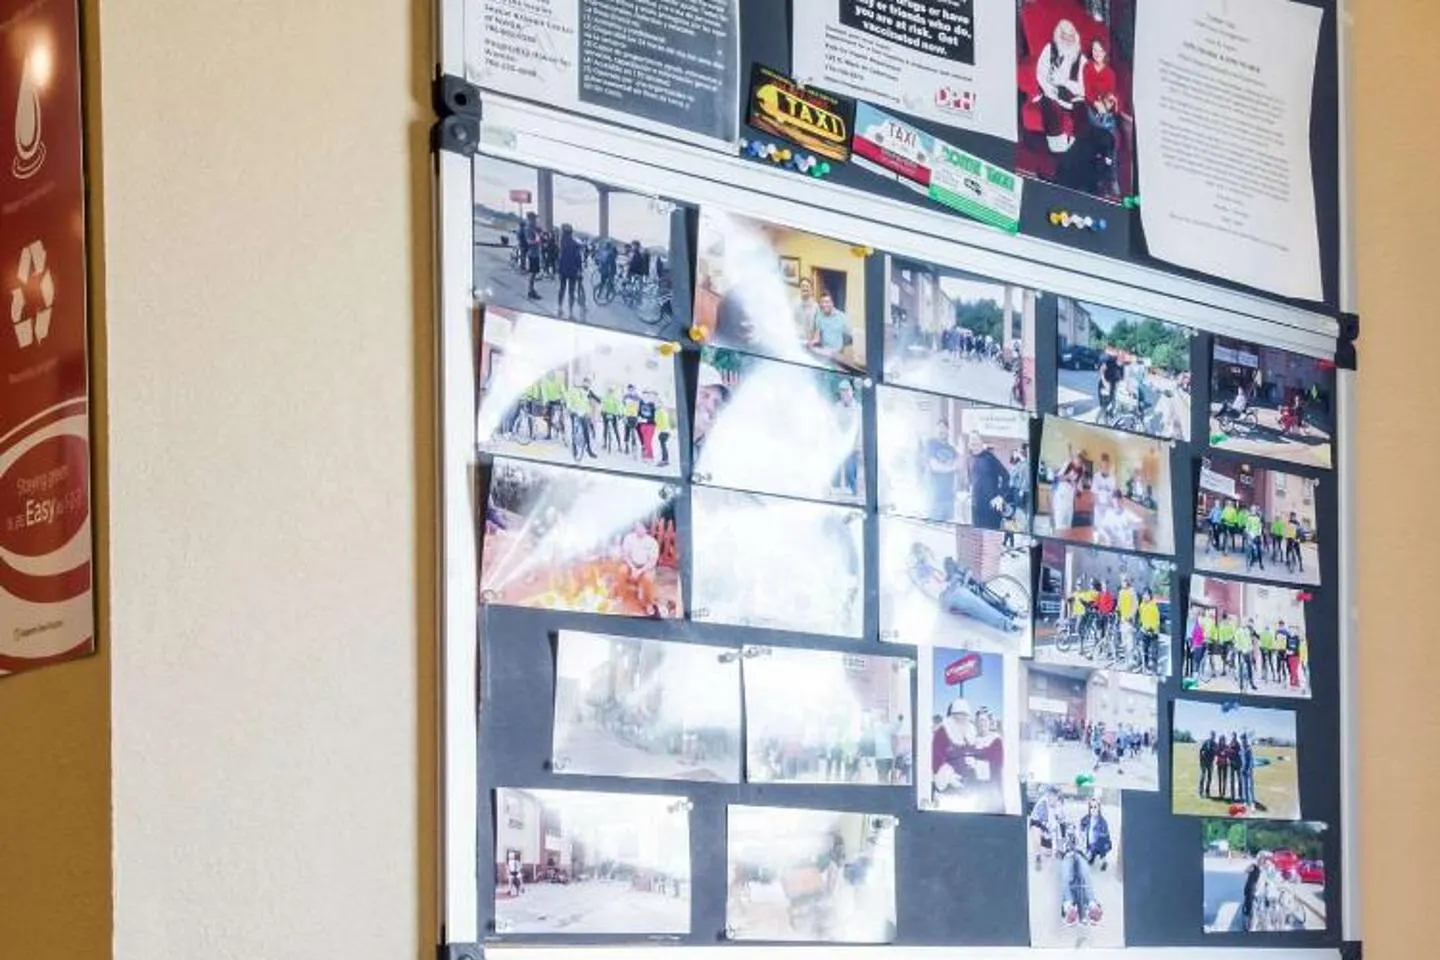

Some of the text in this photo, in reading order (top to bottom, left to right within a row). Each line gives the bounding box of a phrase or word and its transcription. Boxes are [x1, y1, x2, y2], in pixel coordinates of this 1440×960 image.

[855, 5, 875, 19] you
[876, 13, 894, 26] are
[896, 20, 907, 31] at
[908, 23, 933, 39] risk.
[938, 31, 960, 47] Get
[889, 3, 926, 26] friends
[928, 19, 952, 33] who
[942, 8, 971, 25] have
[862, 20, 921, 48] vaccinated
[921, 41, 948, 56] now.
[785, 94, 838, 136] TAXI
[888, 121, 918, 149] TAXI
[26, 497, 57, 527] Easy
